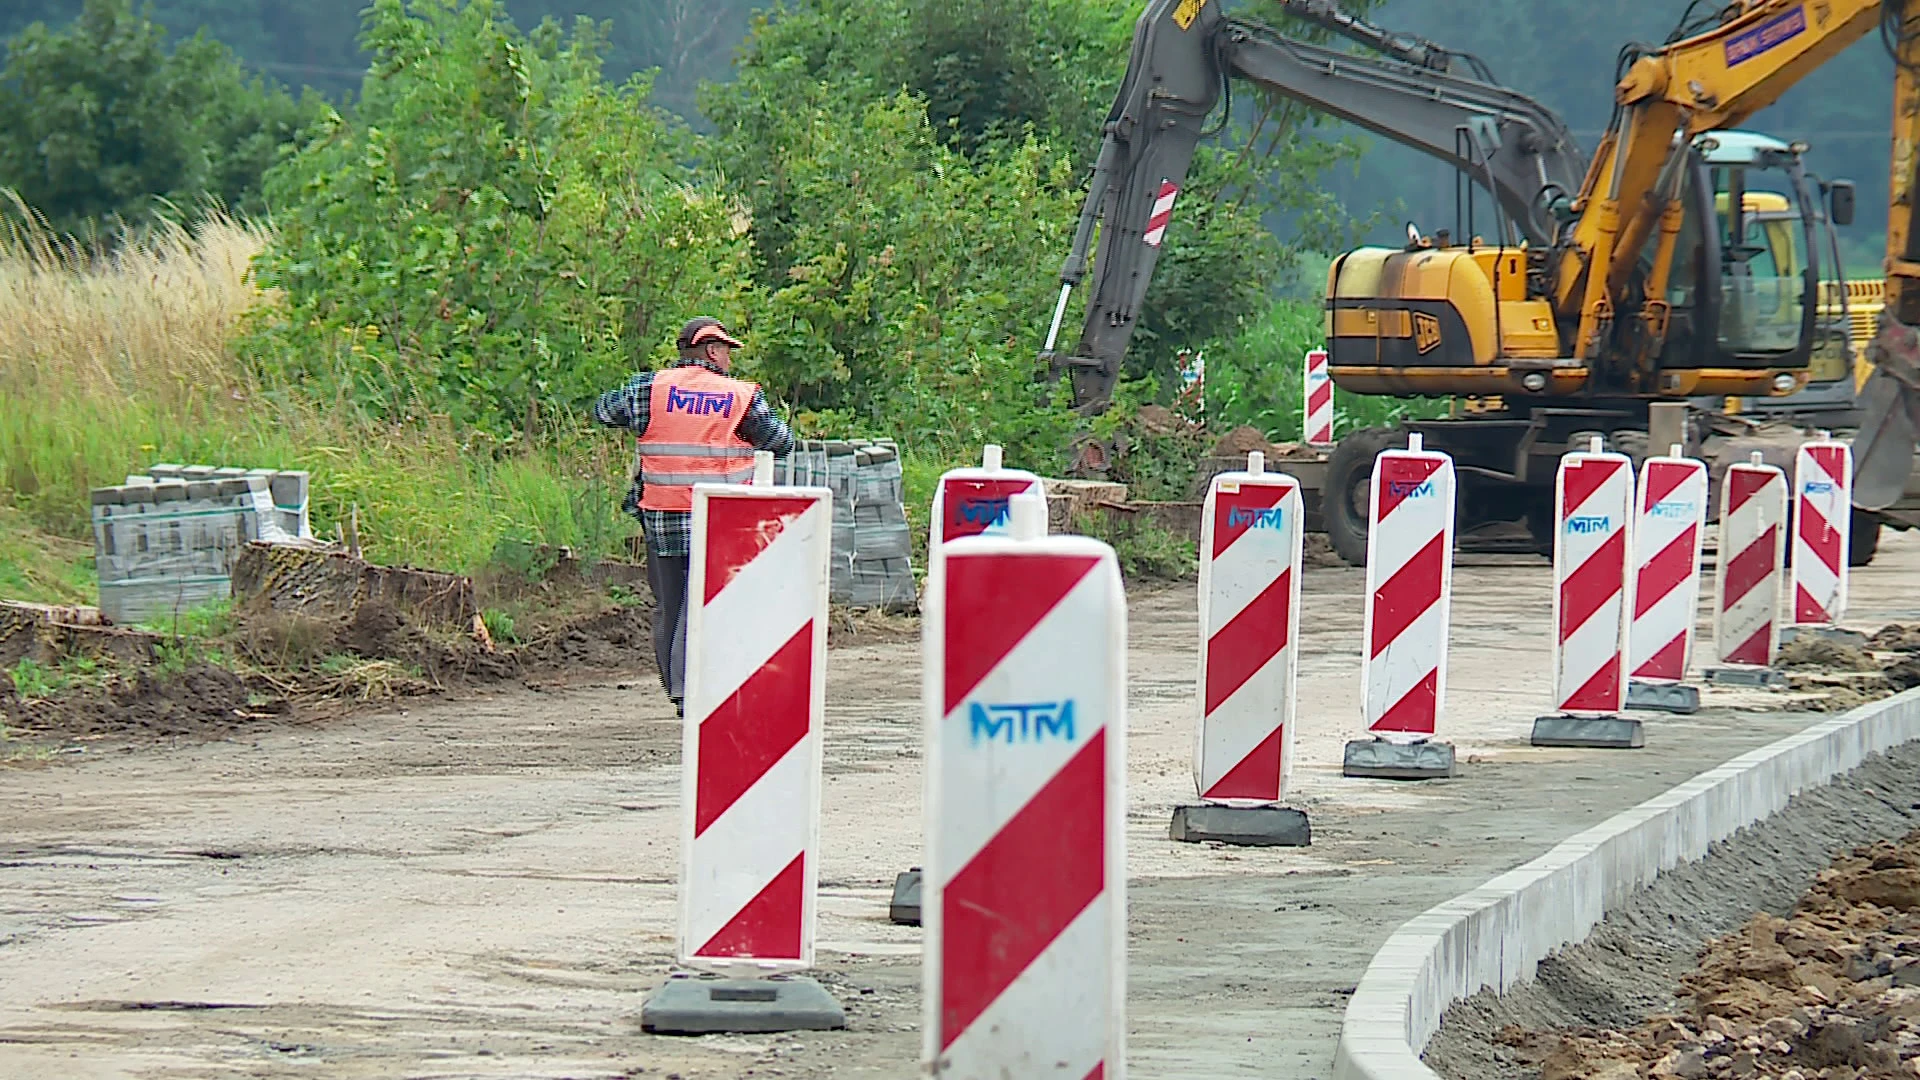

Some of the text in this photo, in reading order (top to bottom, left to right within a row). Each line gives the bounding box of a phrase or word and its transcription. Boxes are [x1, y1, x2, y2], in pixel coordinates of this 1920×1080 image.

[667, 386, 734, 418] MTM
[1228, 505, 1283, 530] MTM
[1567, 515, 1611, 534] MTM
[968, 698, 1075, 744] MTM
